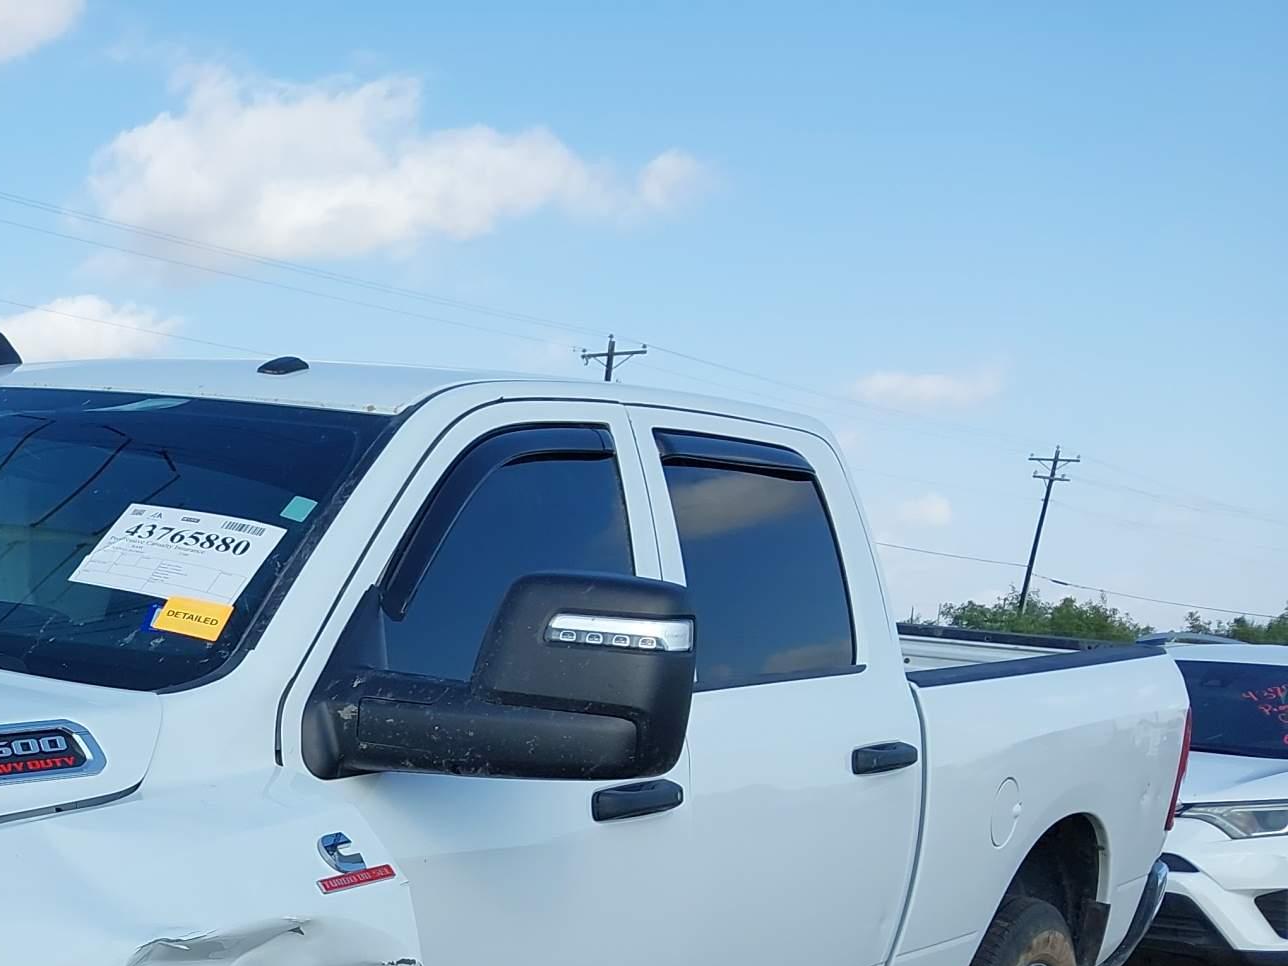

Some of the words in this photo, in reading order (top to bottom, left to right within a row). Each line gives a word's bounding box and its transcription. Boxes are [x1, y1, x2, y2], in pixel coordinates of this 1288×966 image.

[125, 522, 251, 556] 43765880
[167, 609, 219, 626] DETAILED
[27, 757, 76, 772] DUTY
[357, 866, 391, 881] DISEL
